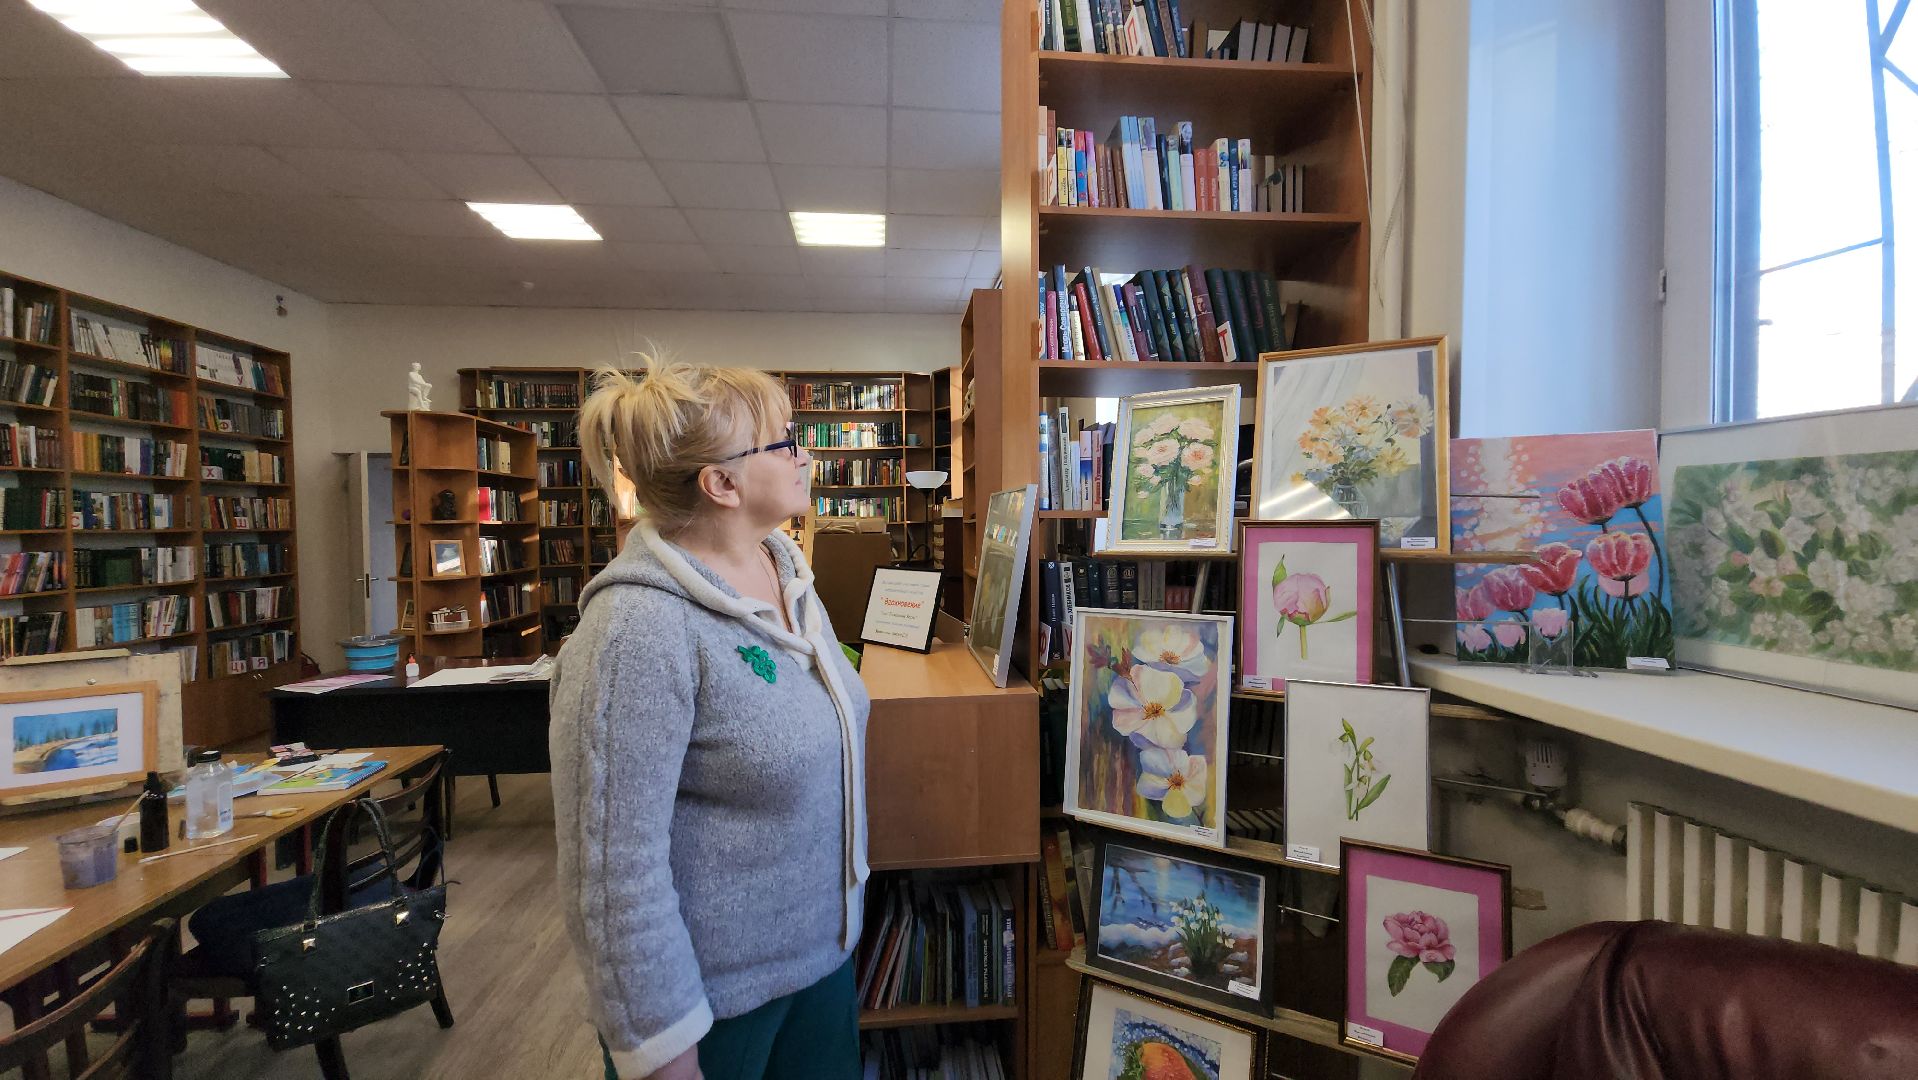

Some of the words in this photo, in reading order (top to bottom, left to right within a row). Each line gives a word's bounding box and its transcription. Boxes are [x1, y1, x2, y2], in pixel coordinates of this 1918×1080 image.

[1127, 17, 1138, 53] П
[1059, 290, 1069, 330] Северянин
[1061, 331, 1070, 353] Игорь
[1217, 329, 1229, 356] Т
